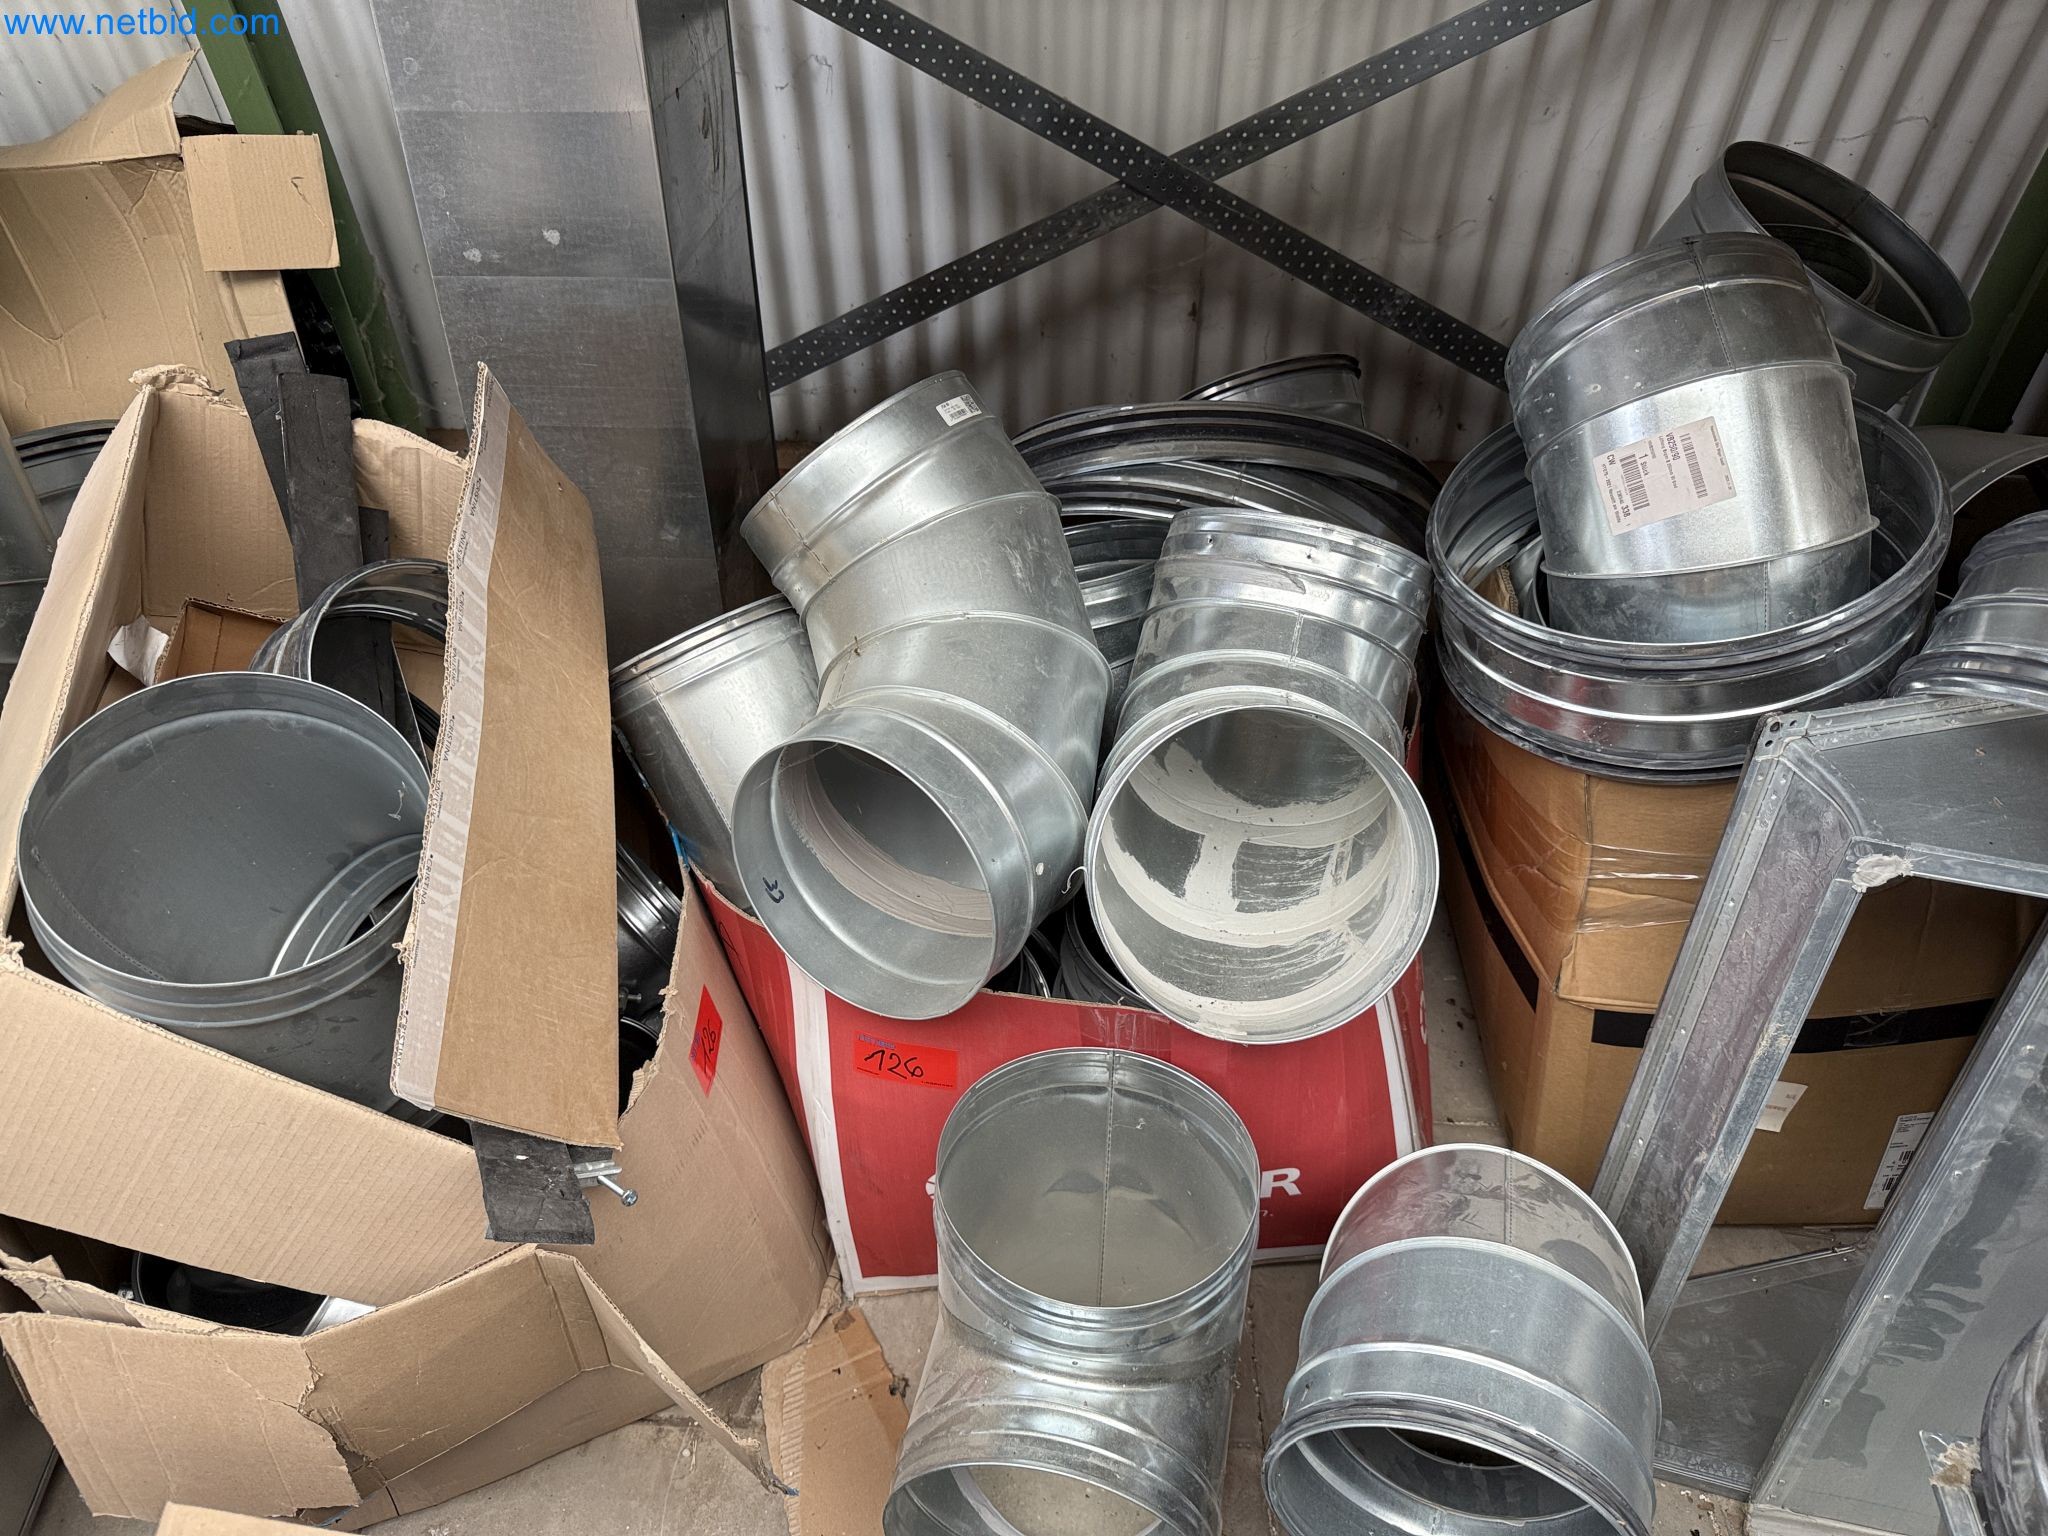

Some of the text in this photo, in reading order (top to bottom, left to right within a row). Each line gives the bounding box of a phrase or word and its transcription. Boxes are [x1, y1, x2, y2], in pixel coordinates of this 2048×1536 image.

[444, 718, 455, 762] CRISTINA
[422, 858, 432, 905] CRISTINA
[863, 1049, 925, 1080] 126
